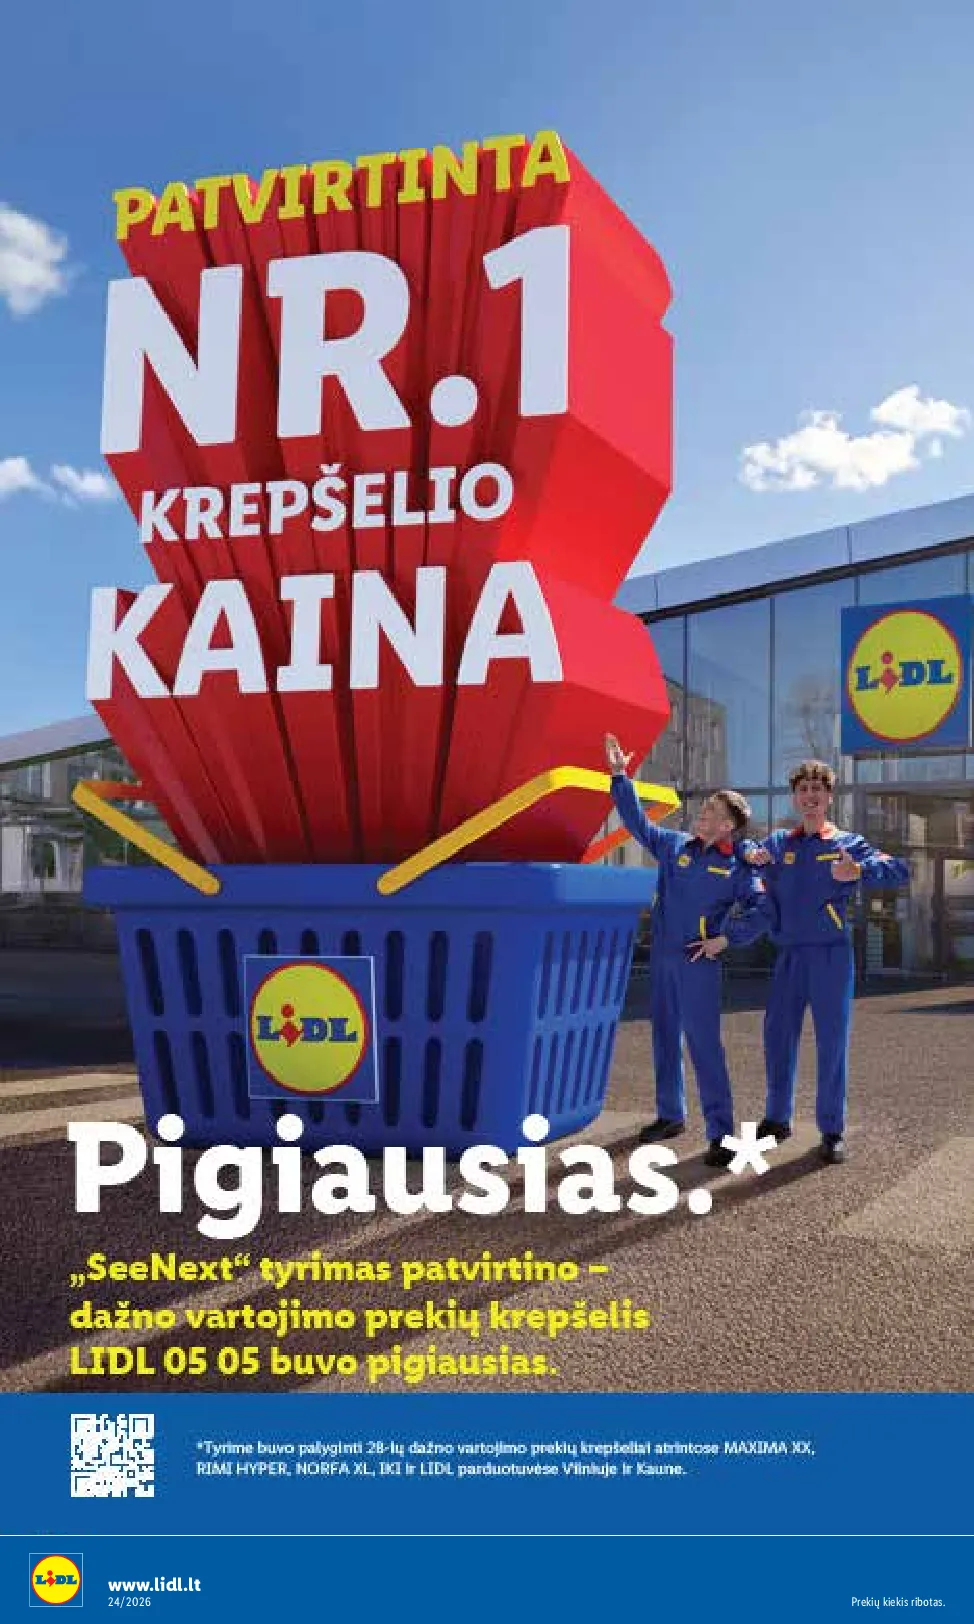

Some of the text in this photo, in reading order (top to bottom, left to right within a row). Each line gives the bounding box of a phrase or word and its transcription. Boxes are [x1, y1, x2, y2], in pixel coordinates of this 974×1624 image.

[112, 129, 571, 240] PATVIRTINTA
[100, 224, 571, 455] NR.1
[140, 462, 515, 544] KREPŠELIO
[86, 560, 563, 701] KAINA
[855, 651, 954, 695] LIDL
[256, 1003, 357, 1047] LIDL
